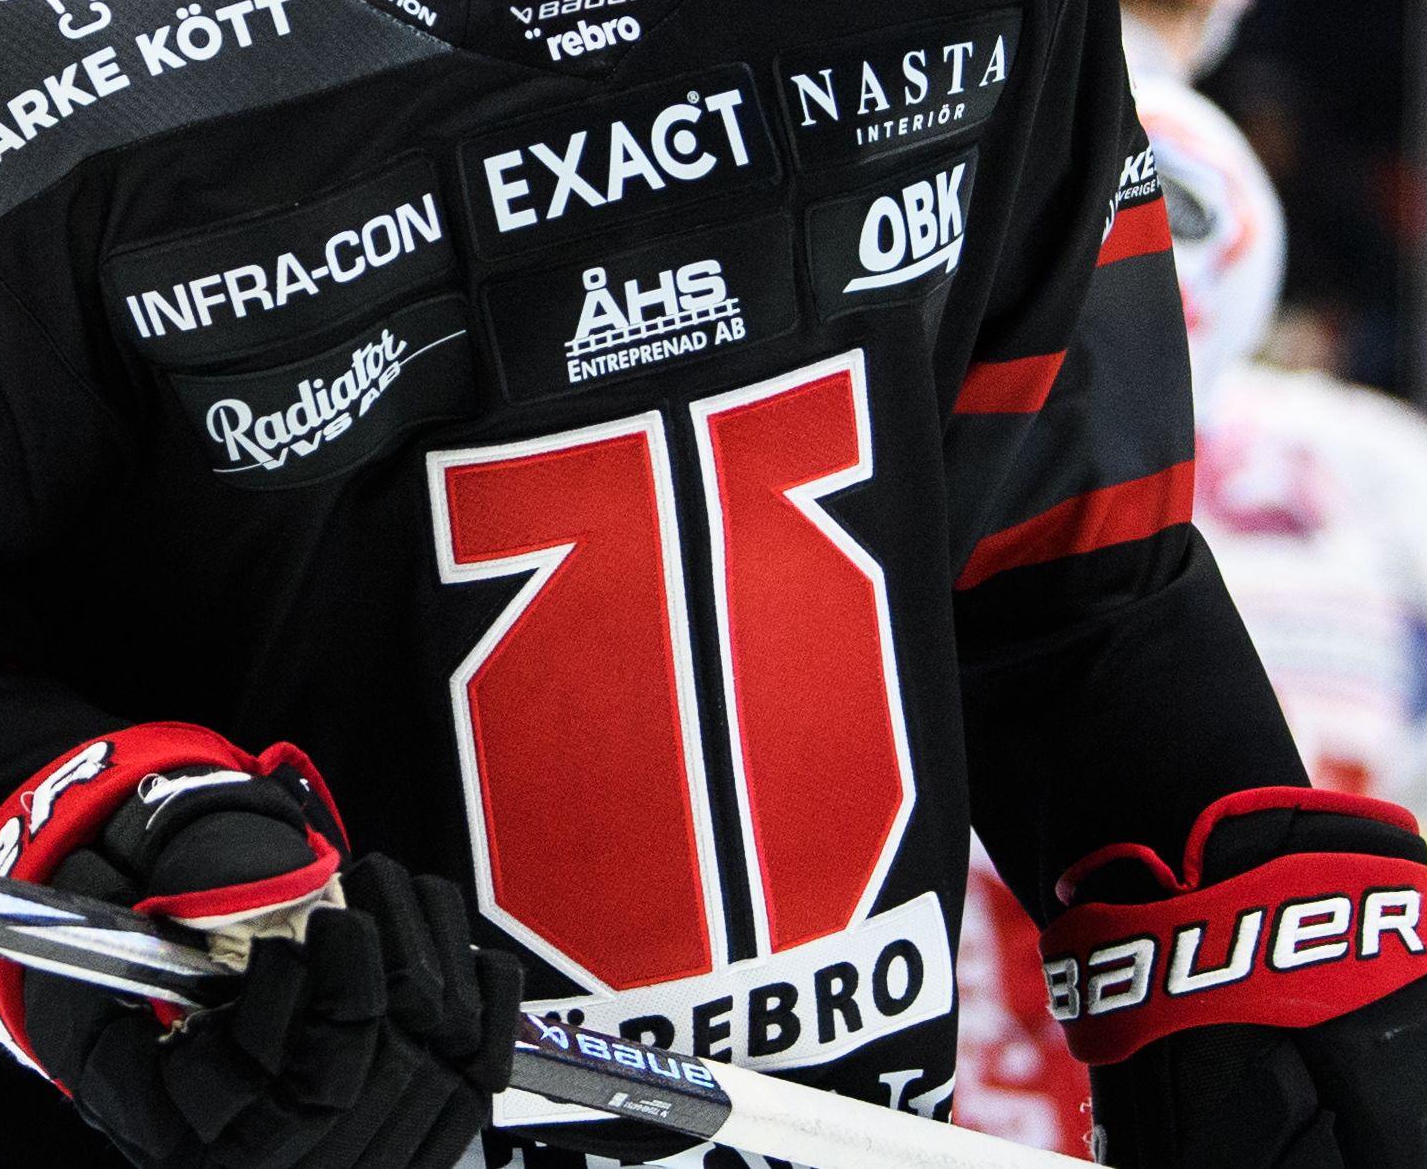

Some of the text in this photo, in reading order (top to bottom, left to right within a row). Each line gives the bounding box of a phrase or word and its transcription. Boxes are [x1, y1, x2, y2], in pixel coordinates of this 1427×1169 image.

[790, 34, 1008, 127] NASTA
[856, 103, 967, 146] INTERIÖR
[126, 193, 442, 339] INFRA-CON
[859, 162, 966, 273] OBK
[567, 317, 746, 384] ENTREPRENAD AB
[575, 258, 728, 341] ÅHS
[206, 329, 408, 462] Radiator
[260, 364, 403, 471] VVS AB
[545, 938, 924, 1063] REBRO
